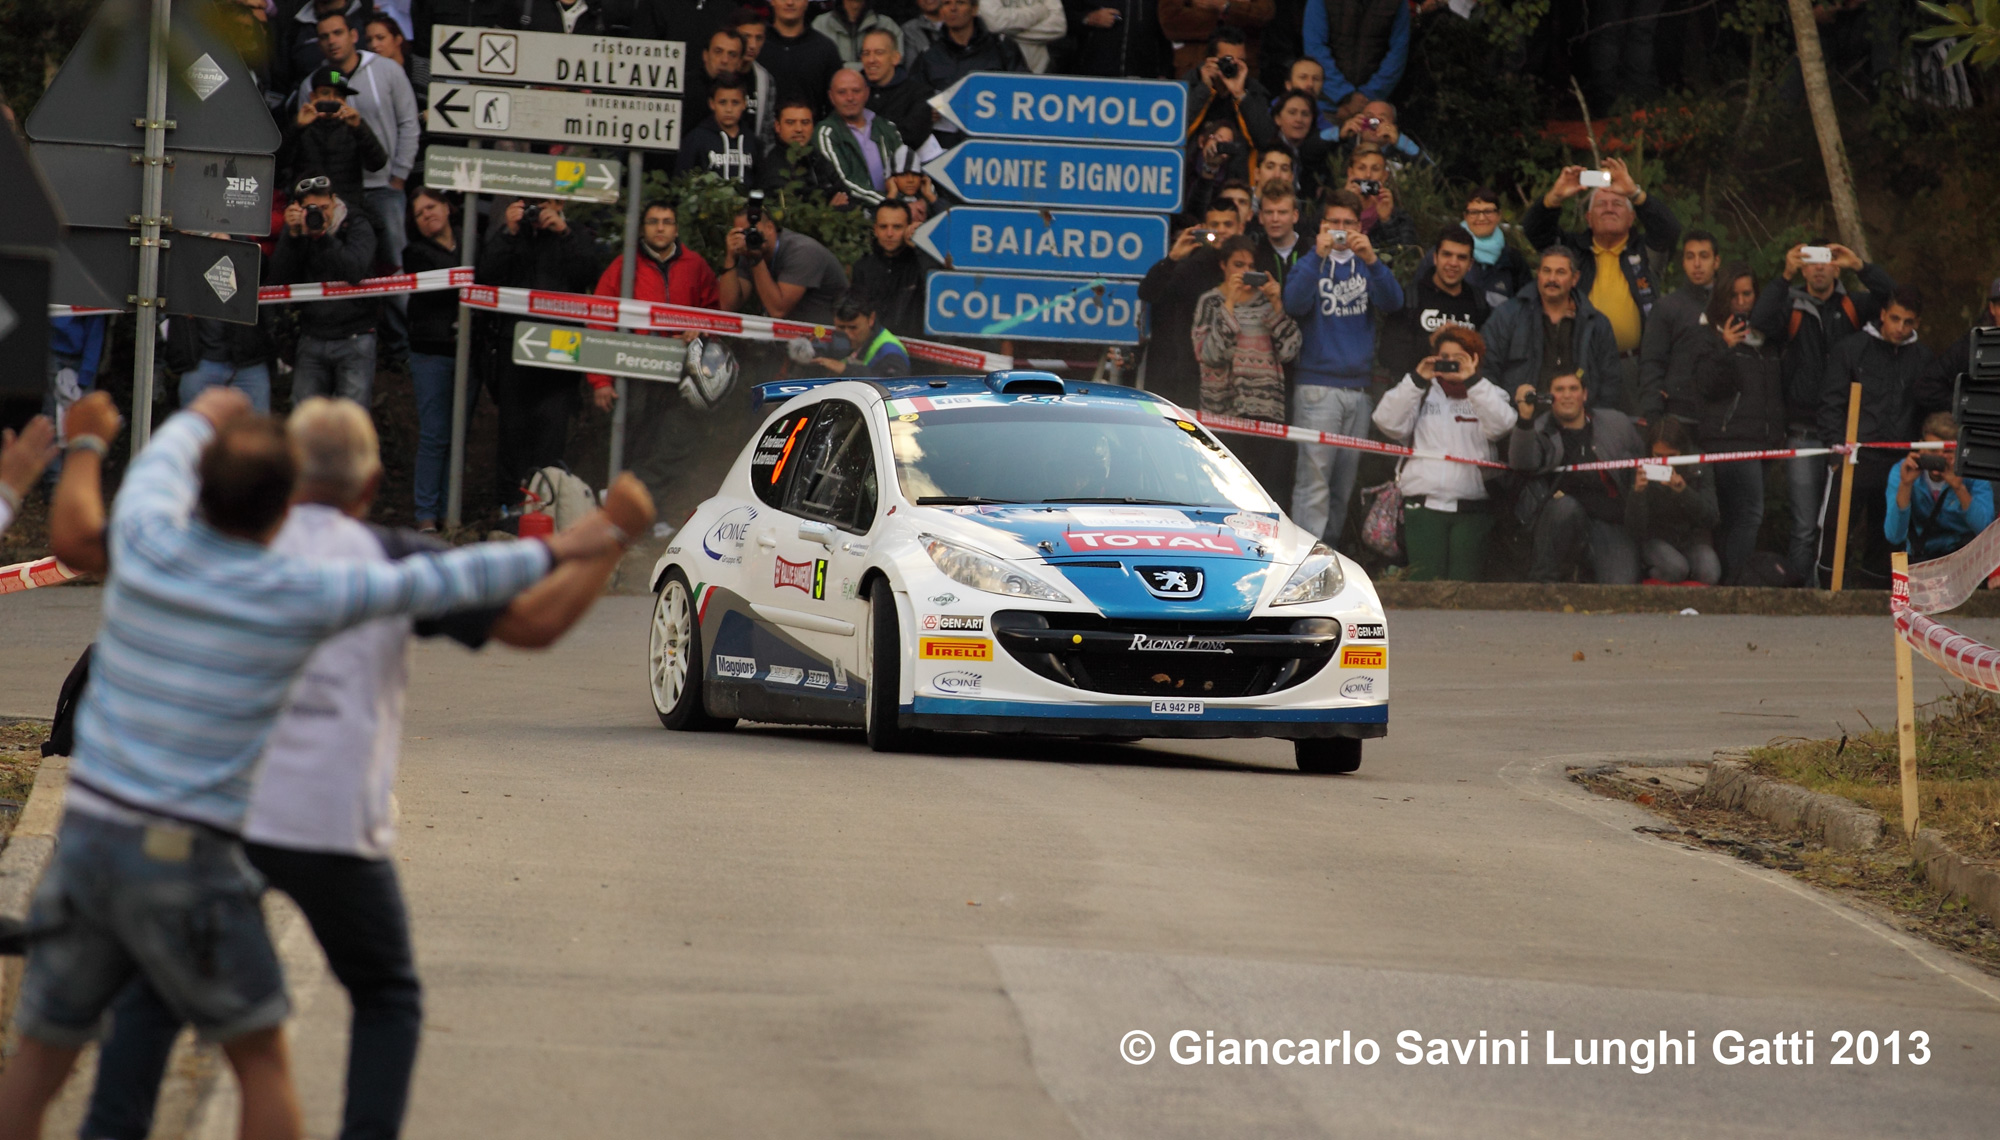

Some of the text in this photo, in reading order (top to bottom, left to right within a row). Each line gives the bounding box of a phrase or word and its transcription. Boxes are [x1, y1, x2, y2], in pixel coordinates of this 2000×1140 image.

[592, 38, 681, 60] ristorante
[557, 58, 678, 89] DALL'AVA
[585, 96, 678, 114] INTERNATIONAL
[974, 90, 1176, 128] S ROMOLO
[564, 113, 676, 144] minigolf
[964, 156, 1173, 195] MONTE BIGNONE
[971, 224, 1143, 261] BAIARDO
[533, 297, 615, 319] DANGEROUS AREA
[614, 351, 683, 373] Percorso
[1201, 412, 1284, 435] DANGEROUS AREA
[771, 416, 808, 484] 5
[1068, 532, 1234, 552] TOTAL
[815, 560, 825, 599] 5
[940, 617, 983, 630] GEN-ART
[1357, 625, 1384, 637] GEN-ART
[926, 642, 987, 658] PIRELLI
[1344, 651, 1382, 665] PIRELLI
[718, 656, 755, 677] Maggiore
[1154, 702, 1201, 713] EA 942 PB
